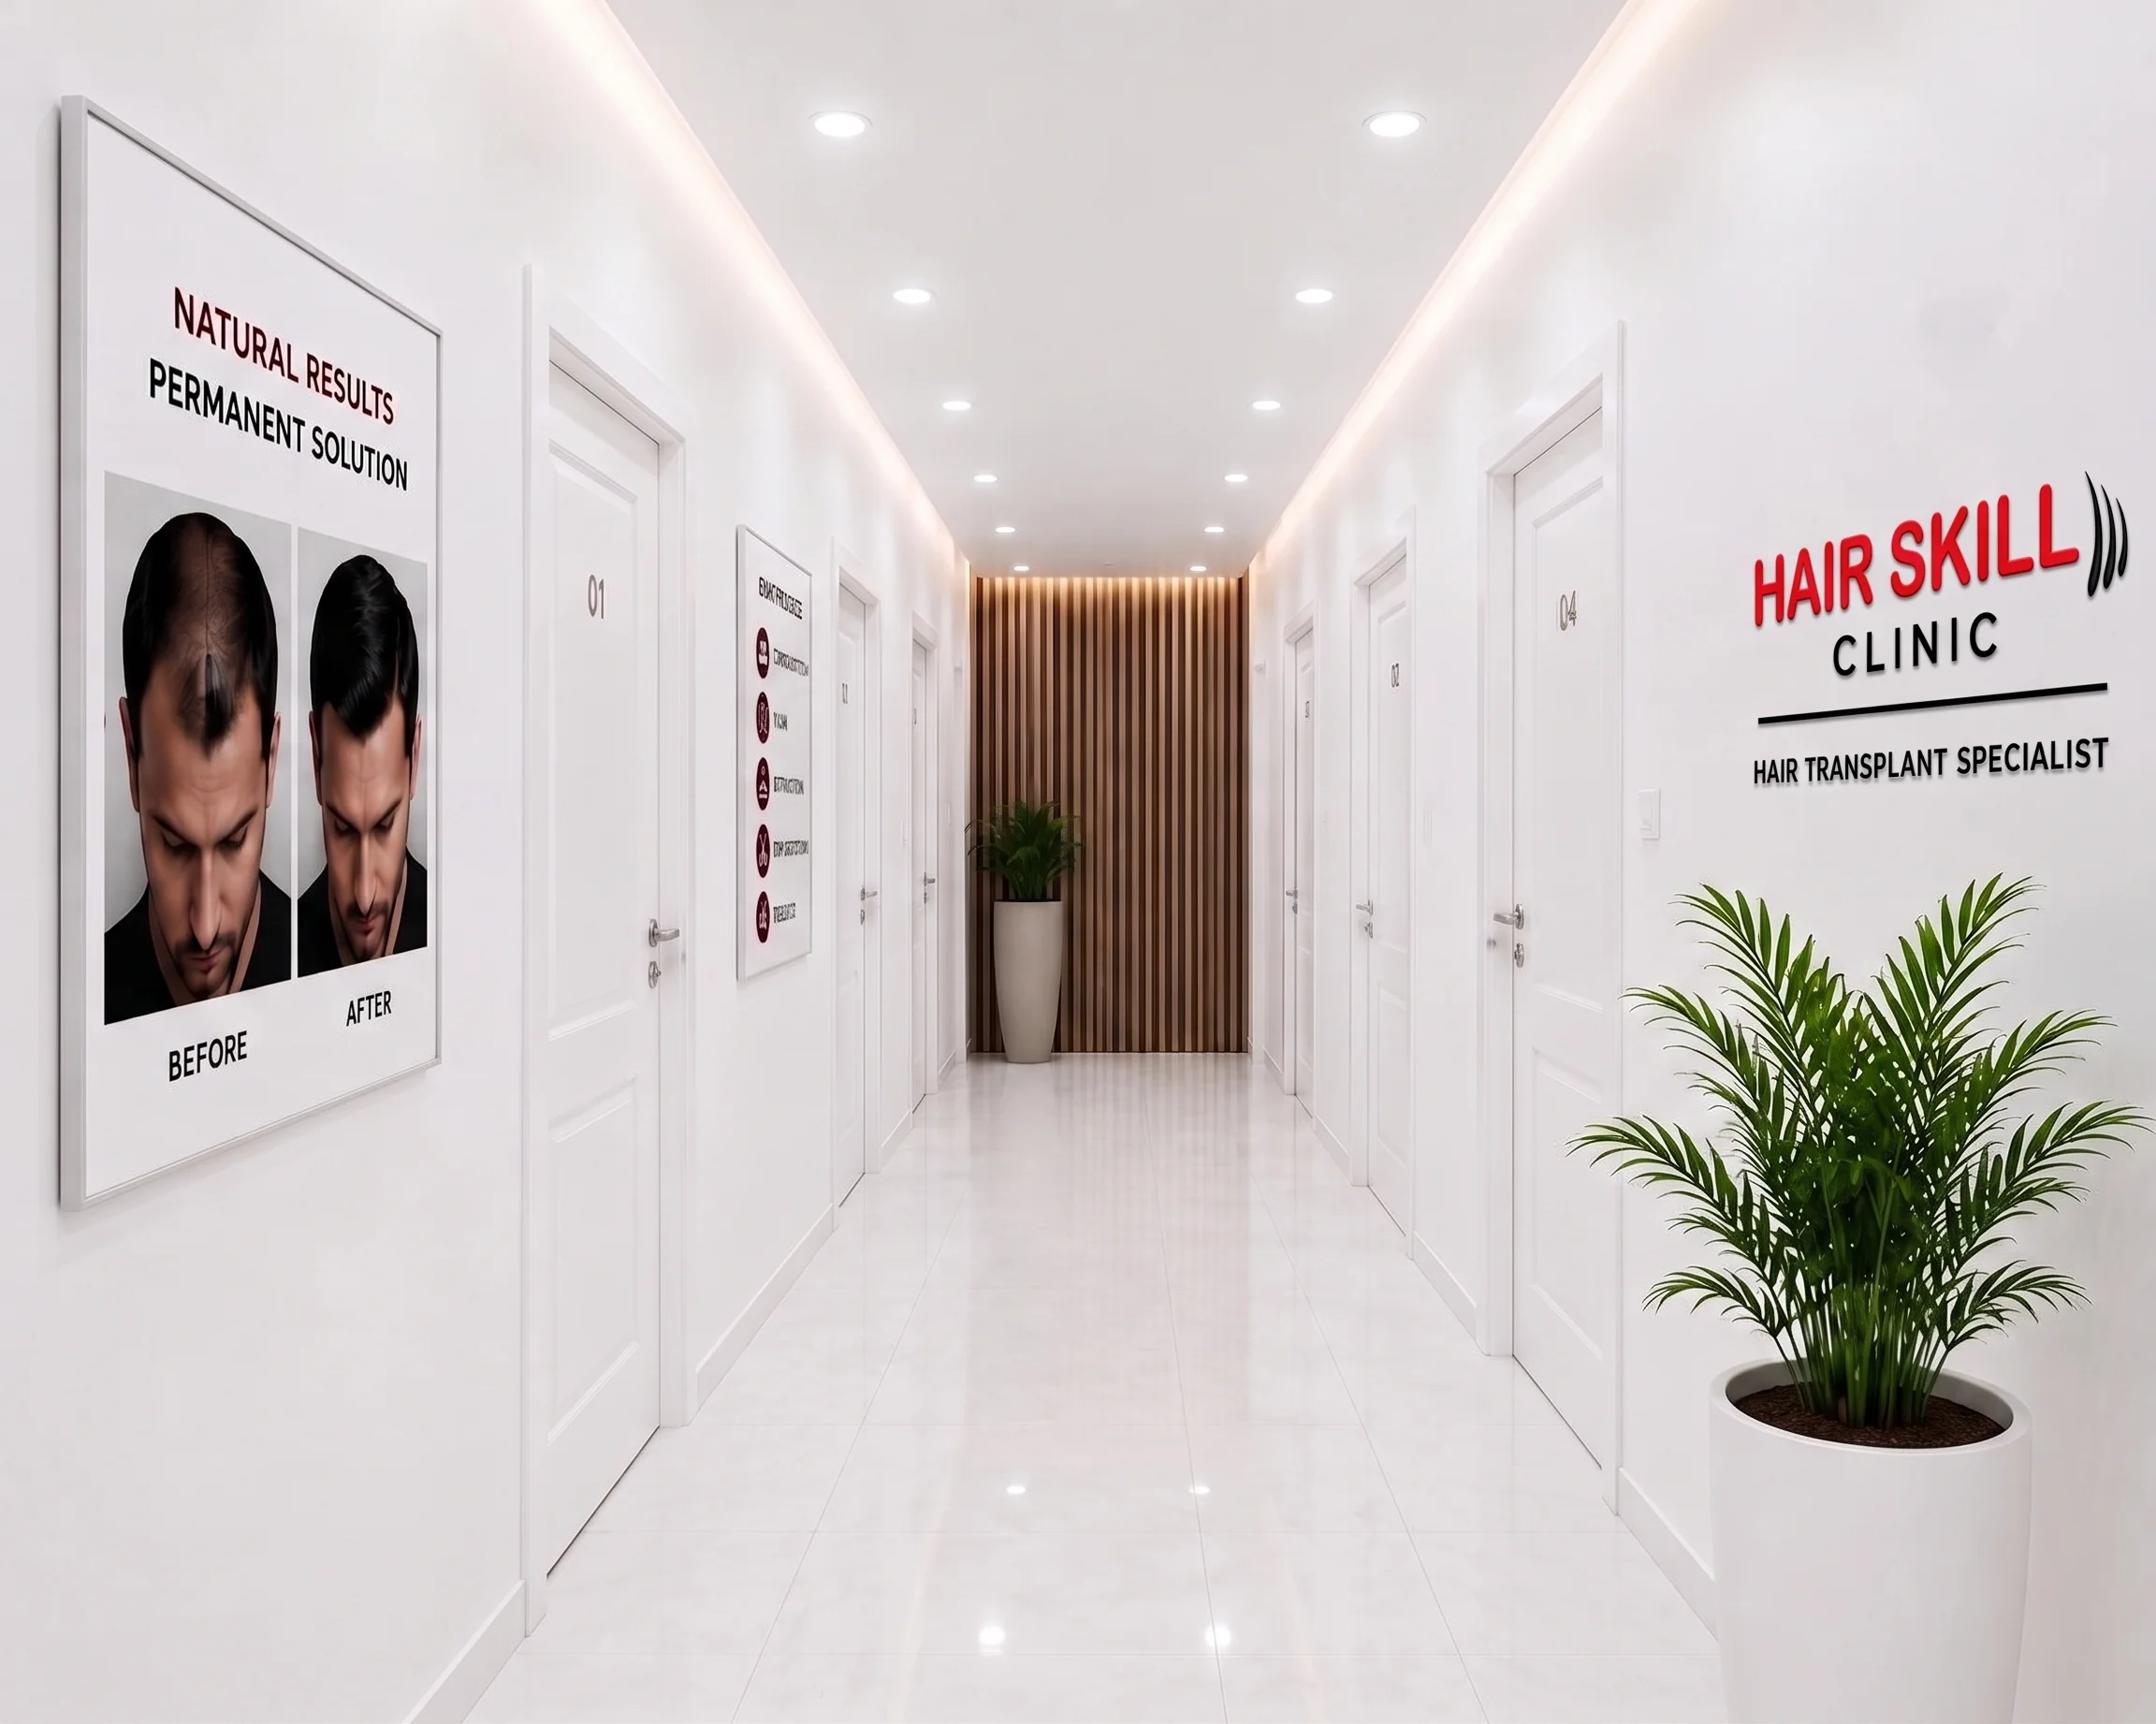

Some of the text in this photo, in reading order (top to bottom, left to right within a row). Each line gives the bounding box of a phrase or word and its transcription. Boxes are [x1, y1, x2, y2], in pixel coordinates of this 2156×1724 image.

[174, 286, 395, 426] NATURAL RESULTS
[150, 358, 408, 491] PERMANENT SOLUTION
[1754, 483, 2080, 628] HAIR SKILL
[588, 574, 605, 620] 01
[1559, 590, 1578, 632] 04
[1832, 611, 1999, 677] CLINIC
[1754, 737, 2110, 784] HAIR TRANSPLANT SPECIALIST
[345, 990, 392, 1027] AFTER
[168, 1030, 248, 1082] BEFORE
